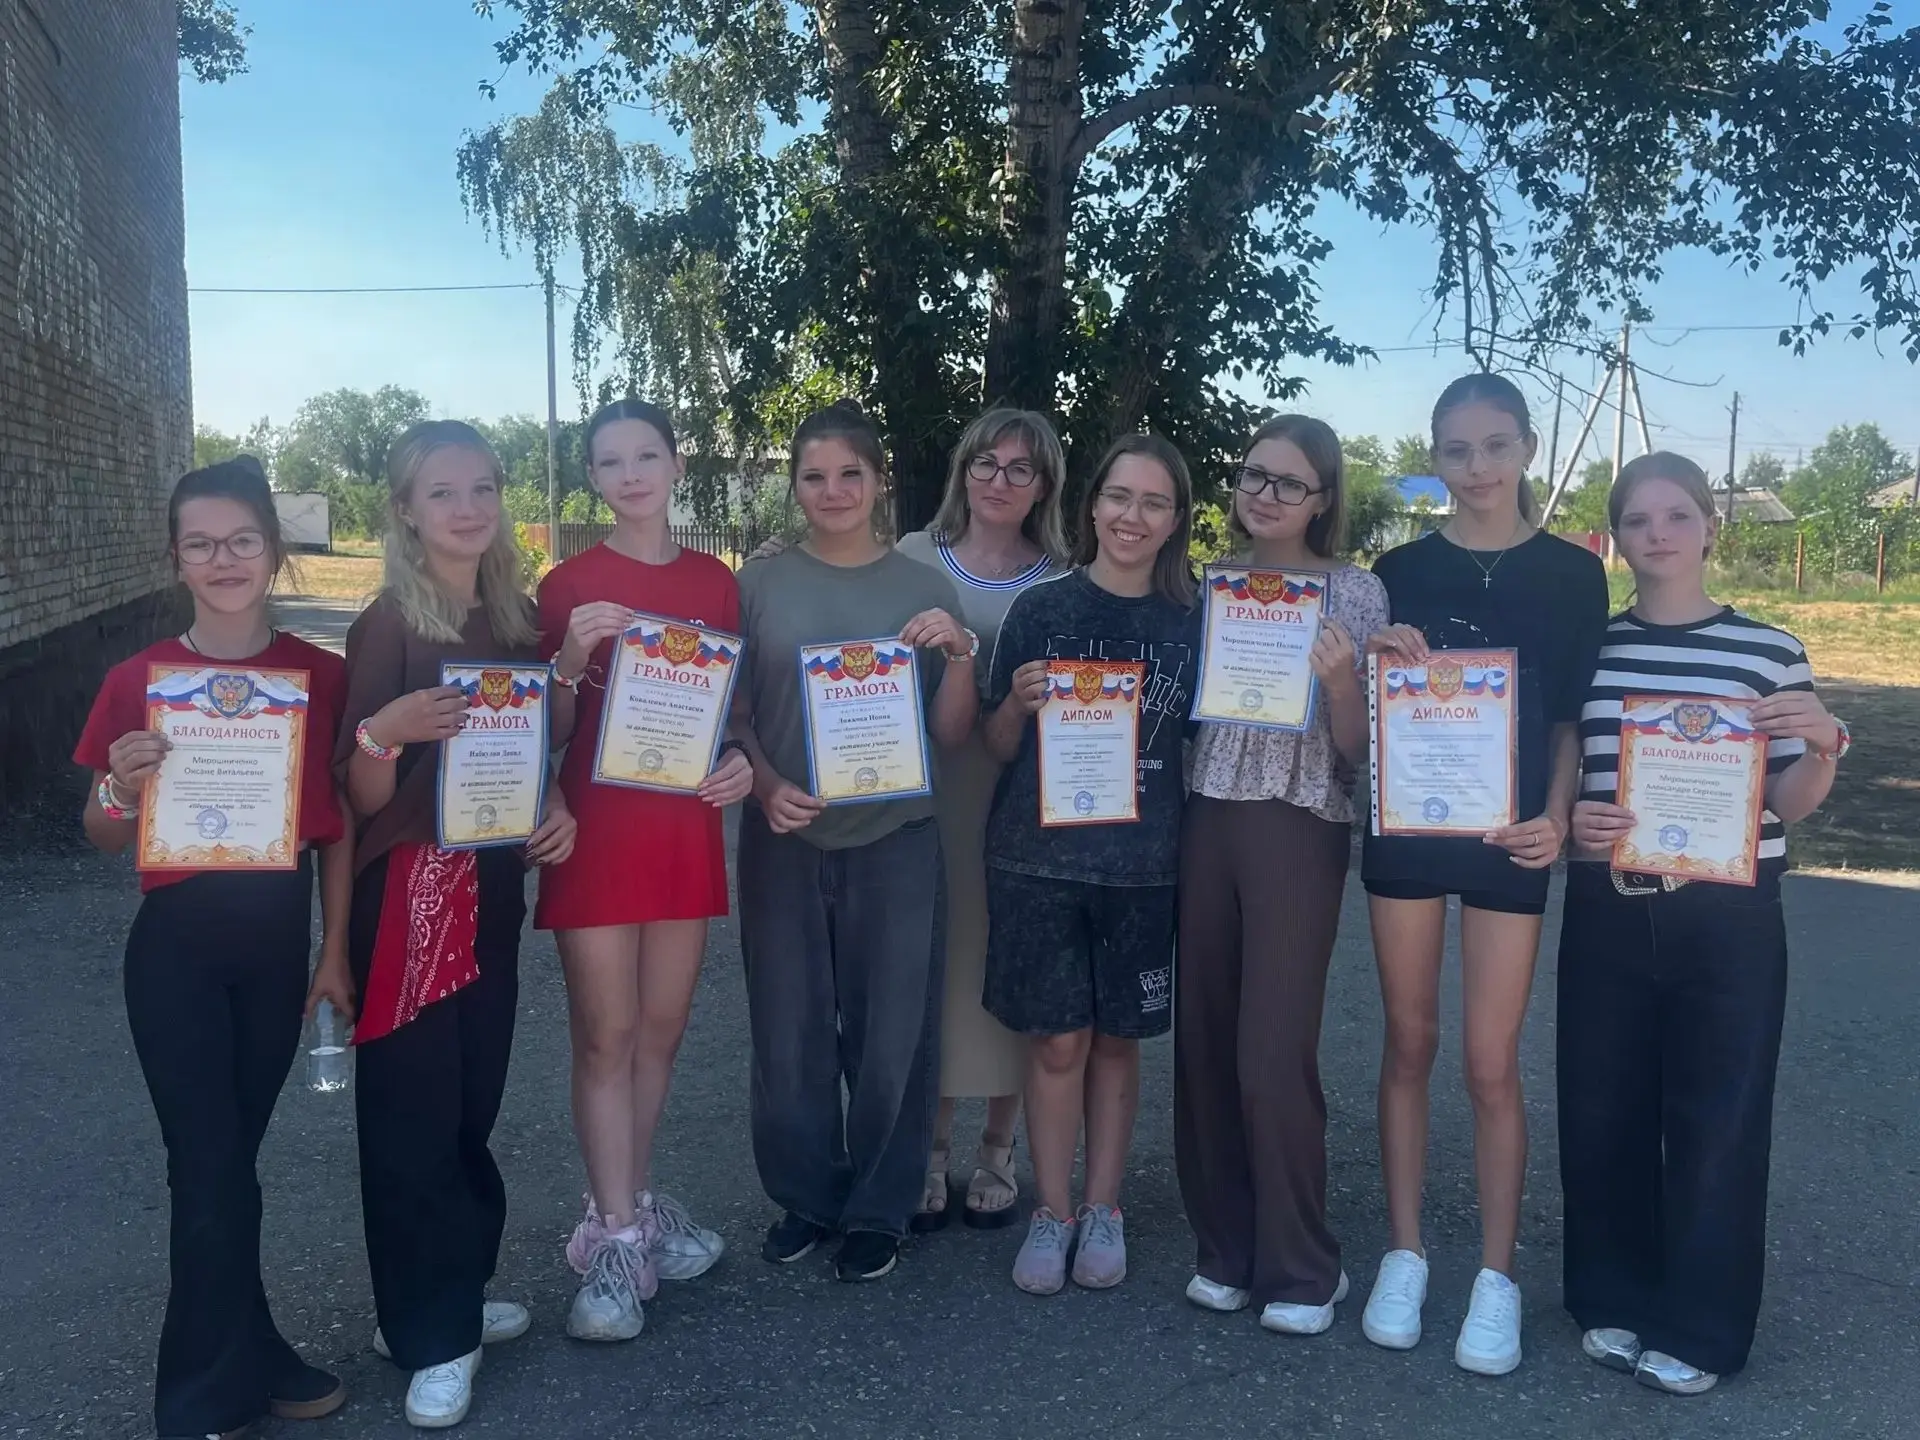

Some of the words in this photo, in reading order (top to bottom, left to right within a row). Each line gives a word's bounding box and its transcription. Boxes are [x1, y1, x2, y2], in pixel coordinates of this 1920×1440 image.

[1225, 605, 1303, 624] ГРАМОТА
[633, 662, 711, 689] ГРАМОТА
[824, 681, 900, 700] ГРАМОТА
[1061, 709, 1113, 722] ДИПЛОМ
[1412, 707, 1479, 720] ДИПЛОМ
[172, 725, 281, 740] БЛАГОДАРНОСТЬ
[1641, 747, 1742, 764] БЛАГОДАРНОСТЬ
